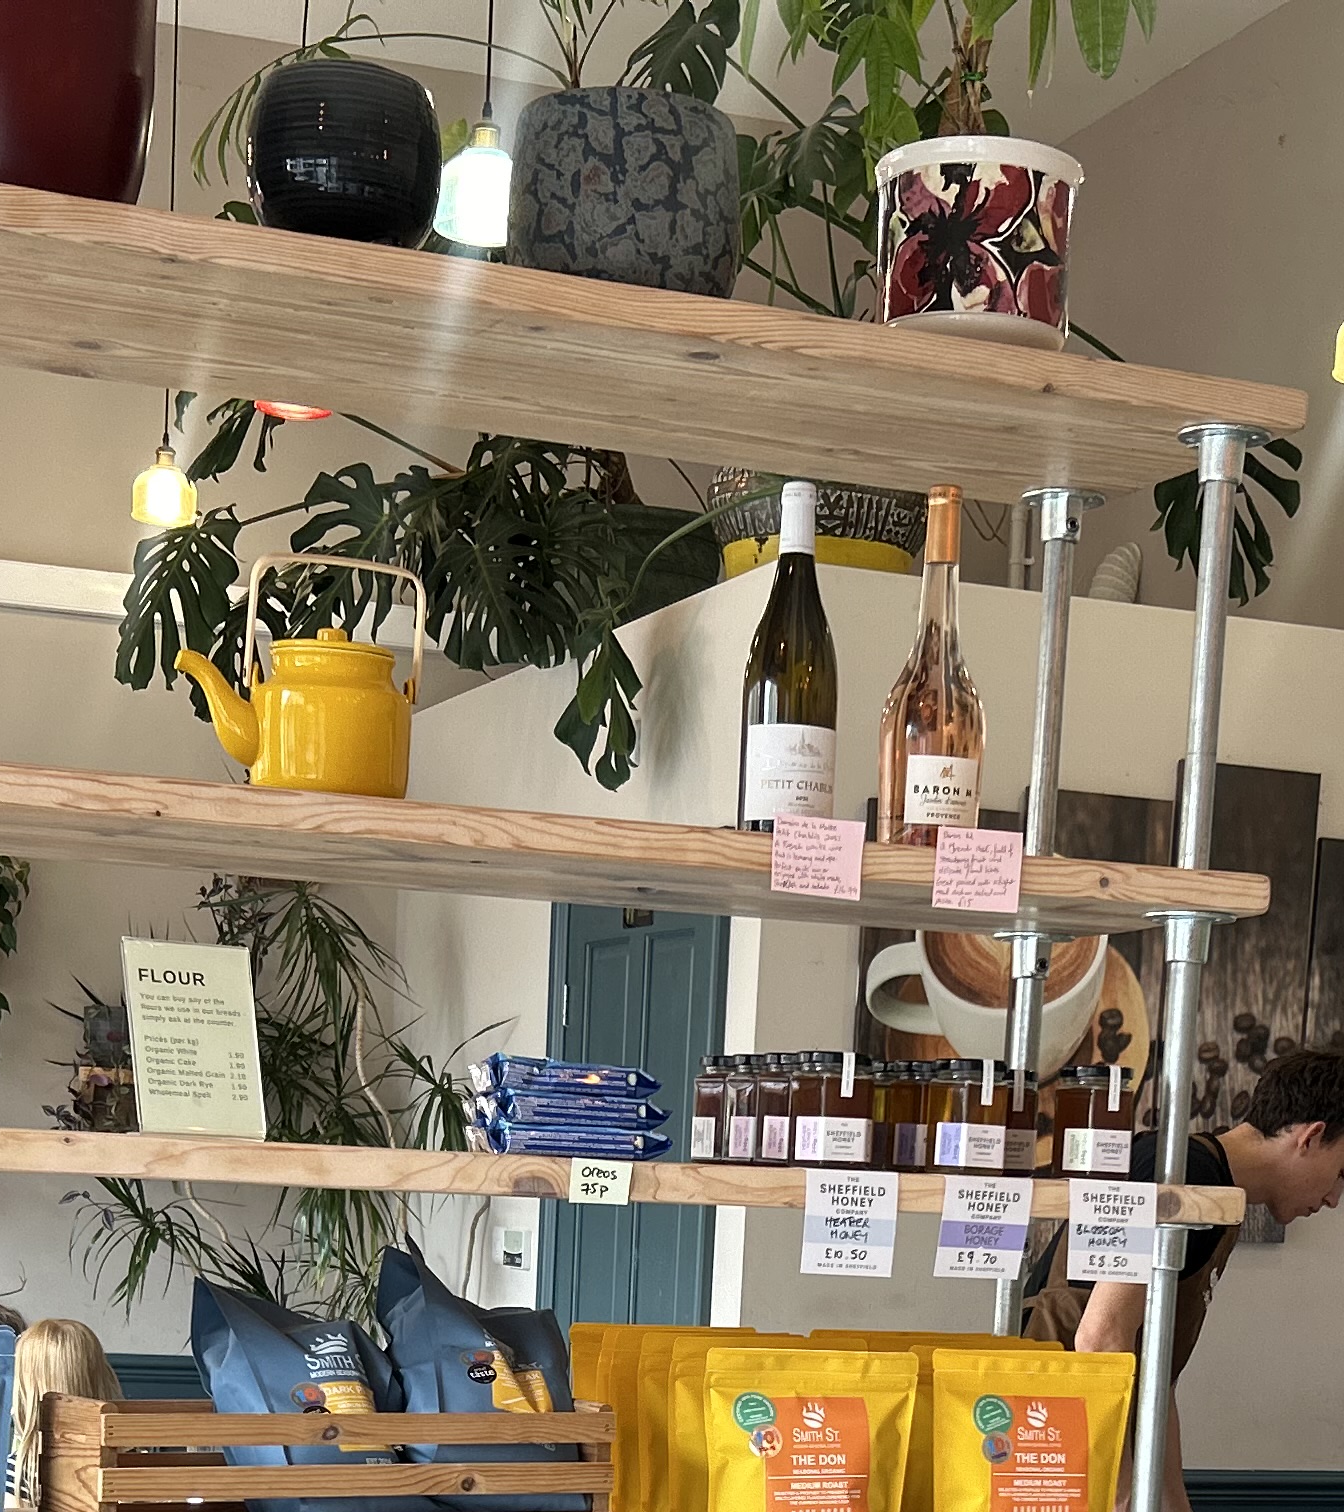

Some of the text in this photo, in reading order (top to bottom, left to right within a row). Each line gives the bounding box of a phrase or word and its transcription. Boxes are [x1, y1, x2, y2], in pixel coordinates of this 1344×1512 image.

[913, 784, 961, 797] BARON
[137, 967, 206, 988] FLOUR
[581, 1165, 618, 1180] Oreos
[580, 1182, 610, 1198] 75p
[819, 1183, 886, 1197] SHEFFIELD
[957, 1188, 1021, 1203] SHEFFIELD
[831, 1195, 874, 1208] HONEY
[1081, 1192, 1146, 1206] SHEFFIELD
[967, 1201, 1009, 1214] HONEY
[1093, 1204, 1134, 1216] HONEY
[963, 1223, 1005, 1237] BORAGE
[964, 1236, 1000, 1247] HONEY
[956, 1250, 998, 1265] £9.70
[323, 1383, 356, 1397] DARK
[789, 1453, 847, 1466] THE DON
[1013, 1451, 1067, 1464] THE DON
